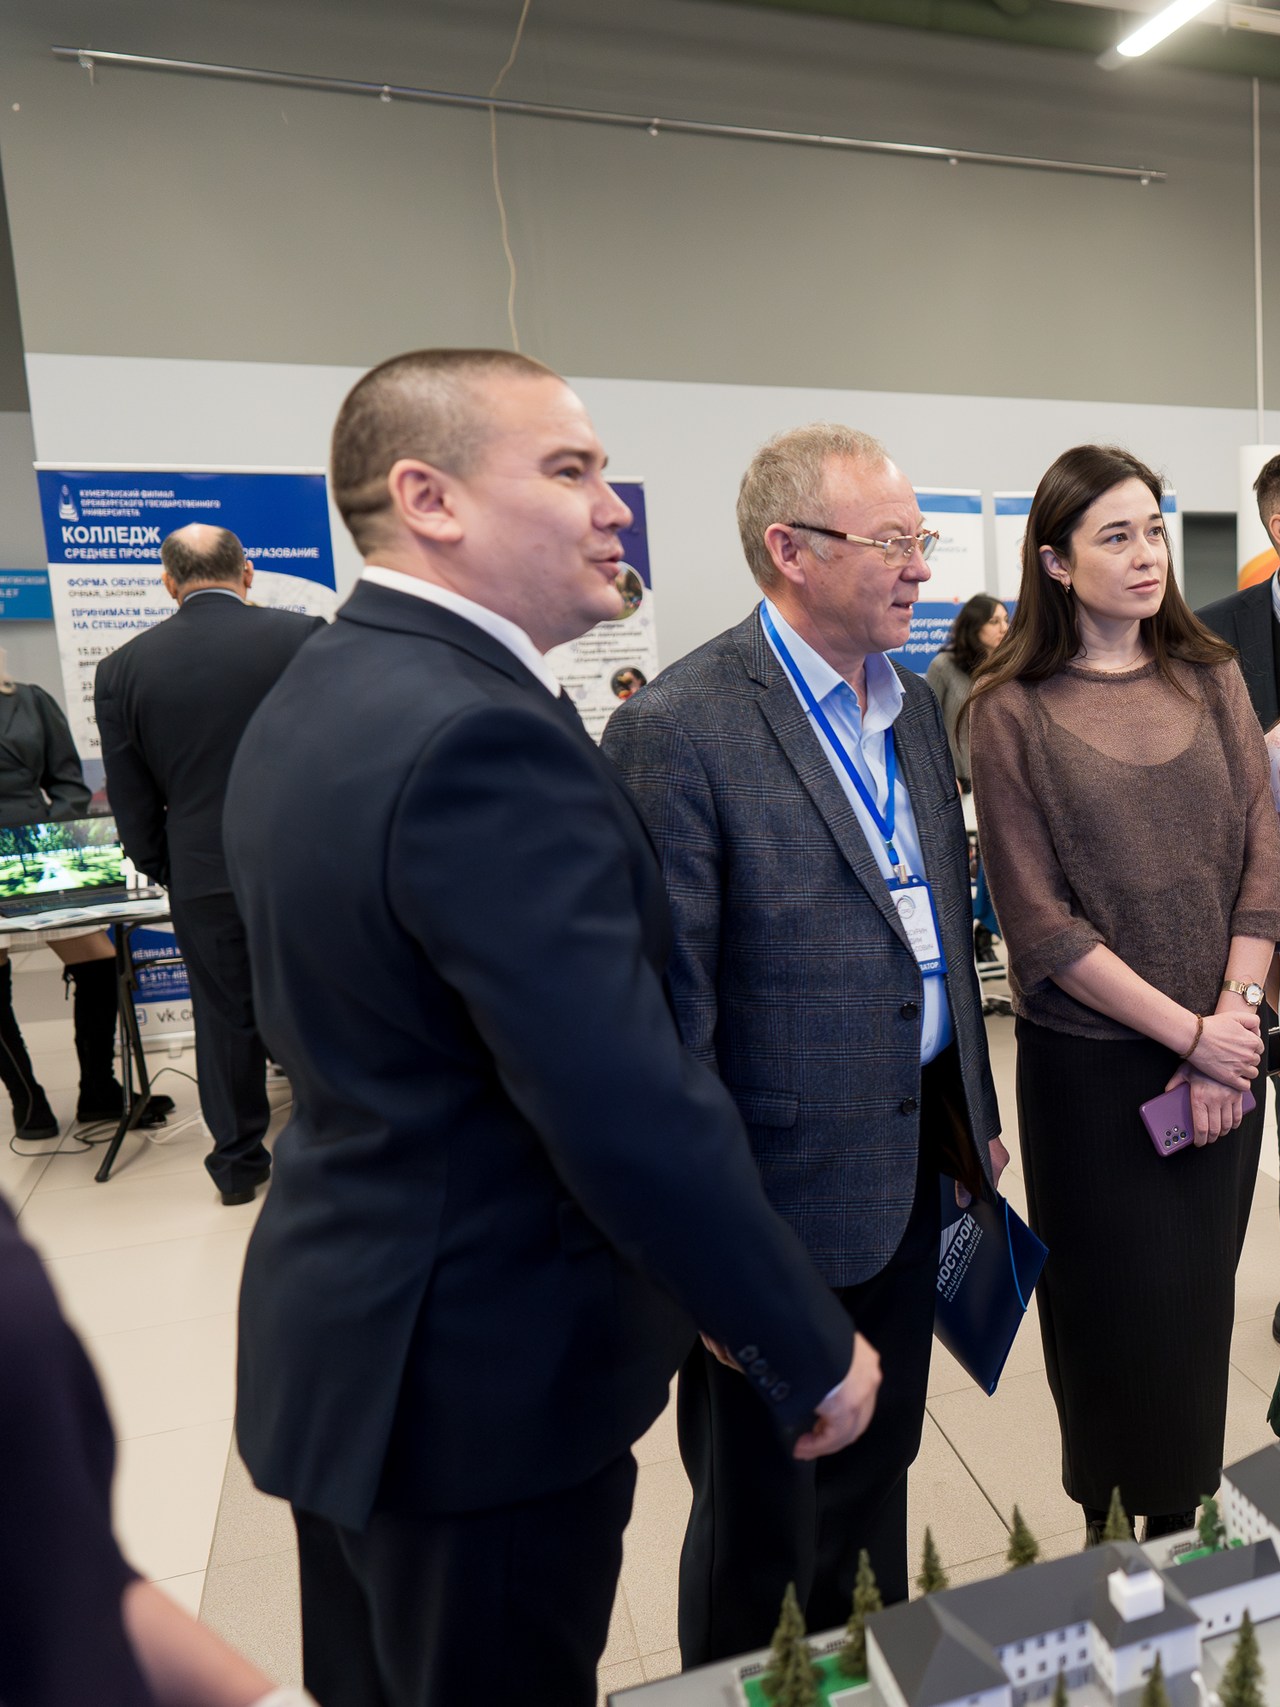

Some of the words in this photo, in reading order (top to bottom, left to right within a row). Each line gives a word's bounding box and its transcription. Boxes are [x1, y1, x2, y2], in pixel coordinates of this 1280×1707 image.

[79, 489, 140, 498] КУМЕРТАУСКИЙ
[141, 490, 175, 498] ФИЛИАЛ
[80, 498, 144, 507] ОРЕНБУРГСКОГО
[145, 499, 221, 509] ГОСУДАРСТВЕННОГО
[82, 507, 141, 517] УНИВЕРСИТЕТА
[61, 526, 162, 547] КОЛЛЕДЖ
[64, 547, 117, 560] СРЕДНЕЕ
[67, 577, 108, 587] ФОРМА
[111, 577, 163, 587] ОБУЧЕНИ
[72, 607, 141, 617] ПРИНИМАЕМ
[73, 621, 88, 630] НА
[943, 1223, 981, 1299] НАЦИОНАЛЬНОЕ
